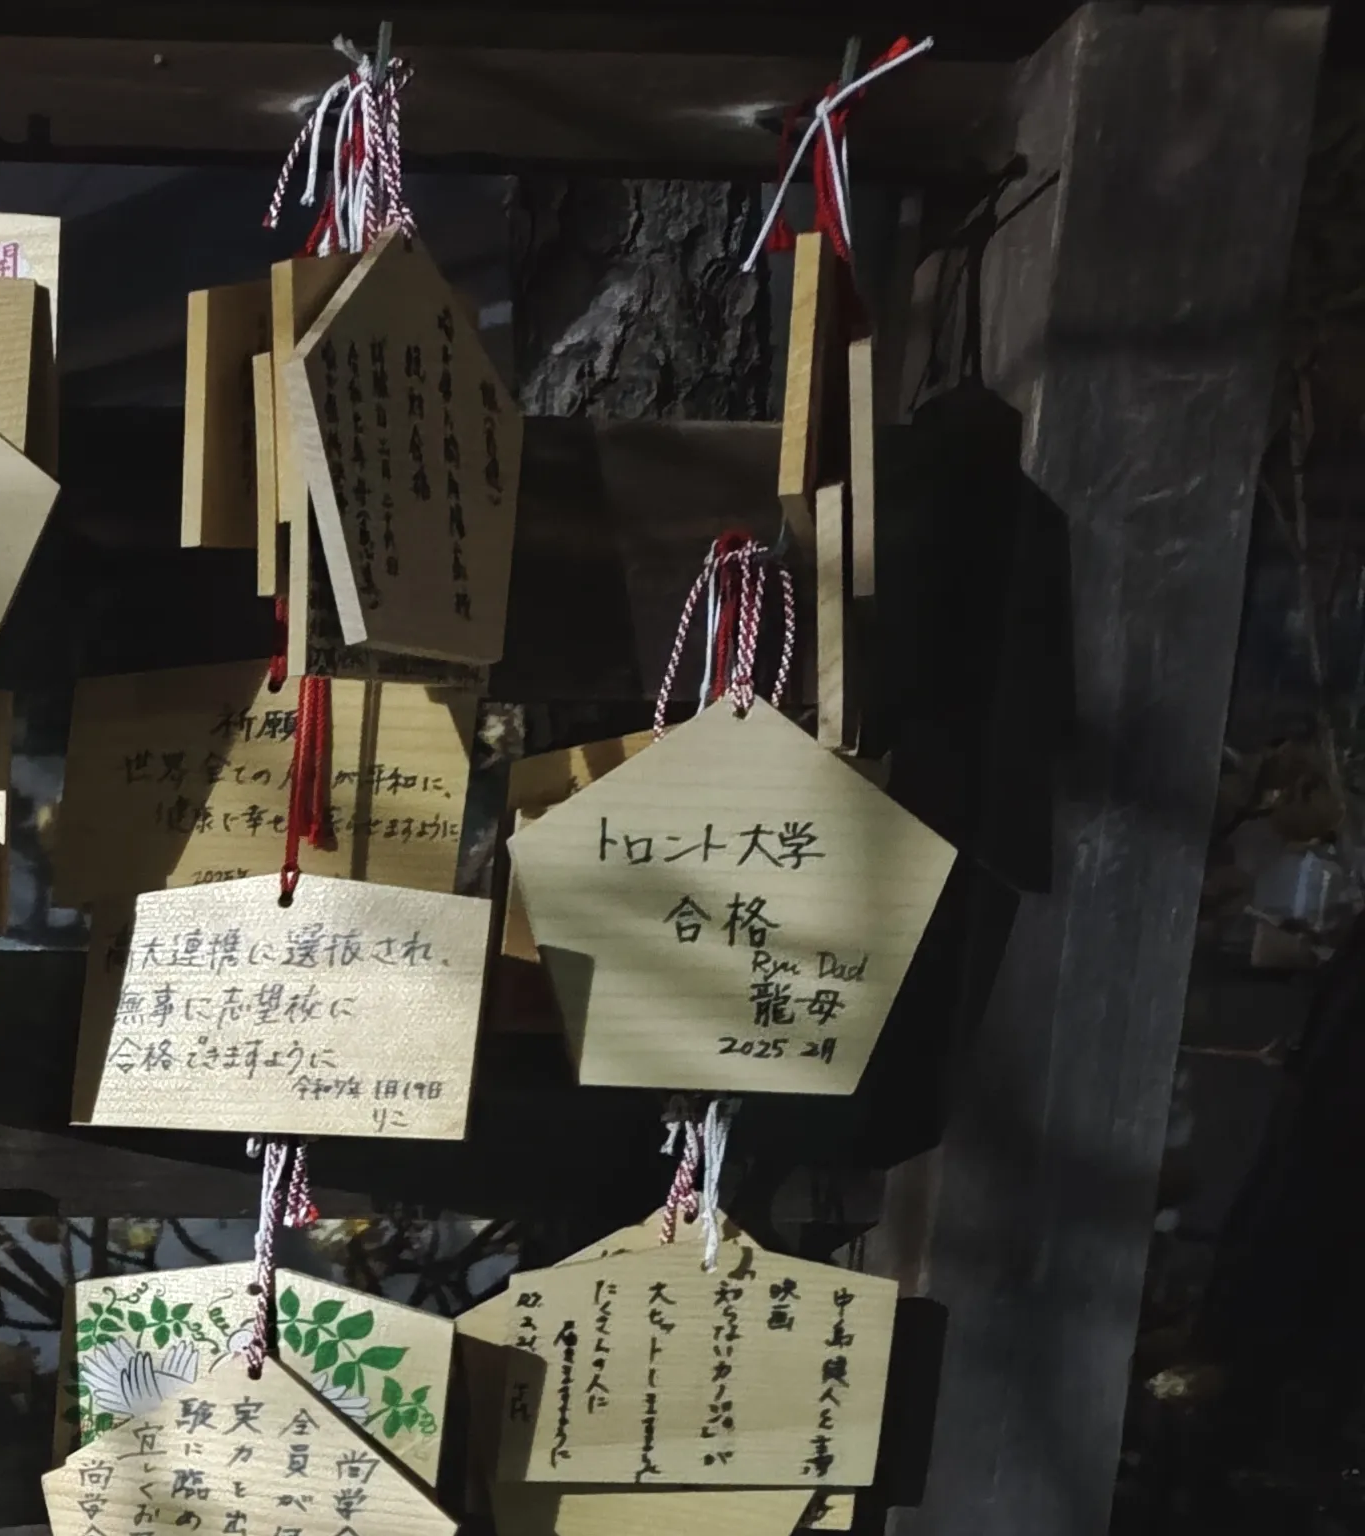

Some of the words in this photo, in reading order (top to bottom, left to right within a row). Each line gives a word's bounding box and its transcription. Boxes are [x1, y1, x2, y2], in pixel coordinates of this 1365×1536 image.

[597, 816, 827, 871] トロント大学
[663, 892, 781, 948] 合格
[717, 1036, 789, 1058] 2025
